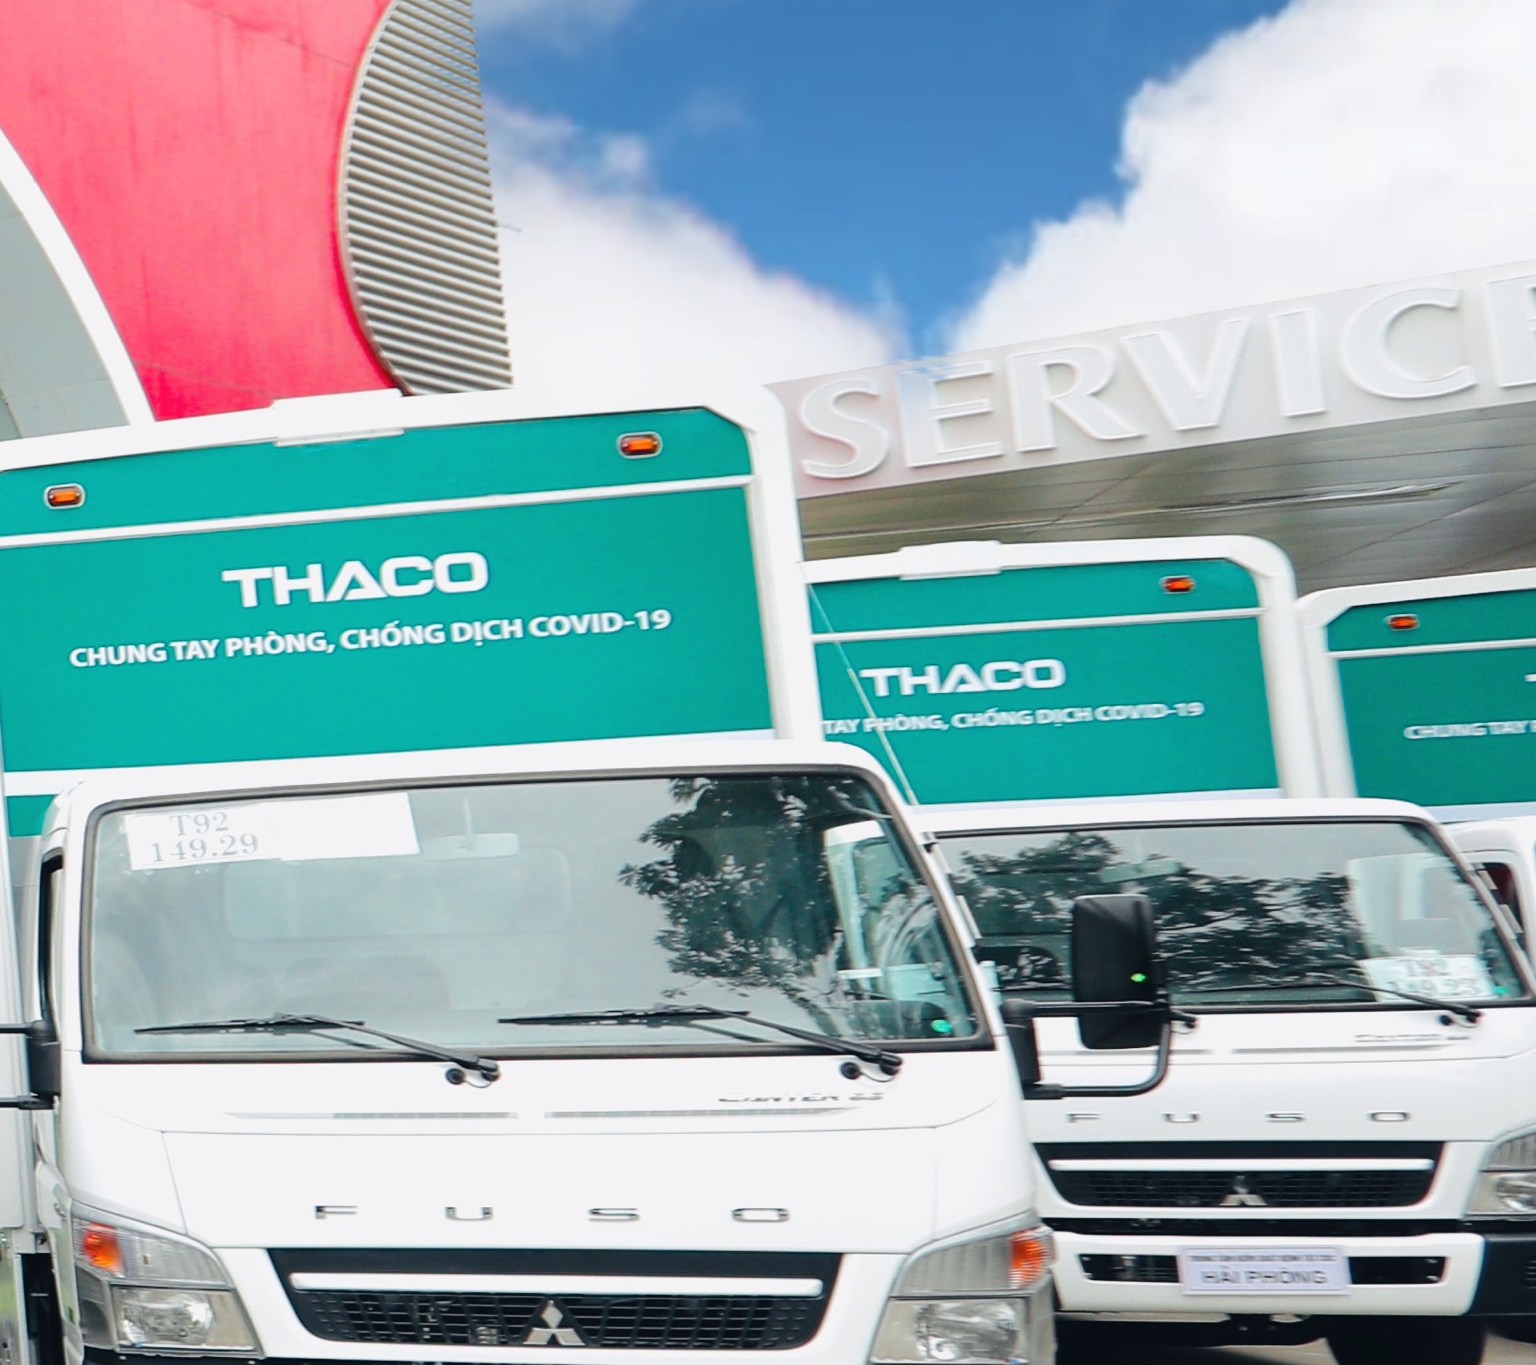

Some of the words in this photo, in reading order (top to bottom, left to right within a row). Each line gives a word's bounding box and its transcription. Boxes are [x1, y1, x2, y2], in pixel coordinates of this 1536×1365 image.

[221, 551, 489, 608] THACO
[69, 642, 167, 668] CHUNG
[171, 638, 219, 661] TAY
[225, 630, 336, 657] PHÒNG,
[339, 620, 445, 650] CHỐNG
[450, 618, 523, 647] DỊCH
[529, 609, 672, 638] COVID-19
[859, 658, 1066, 696] THACO
[824, 718, 858, 734] TAY
[863, 713, 950, 733] PHÒNG,
[951, 707, 1033, 727] CHỐNG
[1035, 707, 1092, 727] DỊCH
[1094, 701, 1205, 722] COVID-19
[1403, 722, 1488, 740] CHUNG
[169, 812, 229, 837] T92
[152, 833, 258, 862] 149.29
[1066, 1110, 1410, 1123] FUSO
[314, 1205, 792, 1223] FUSO
